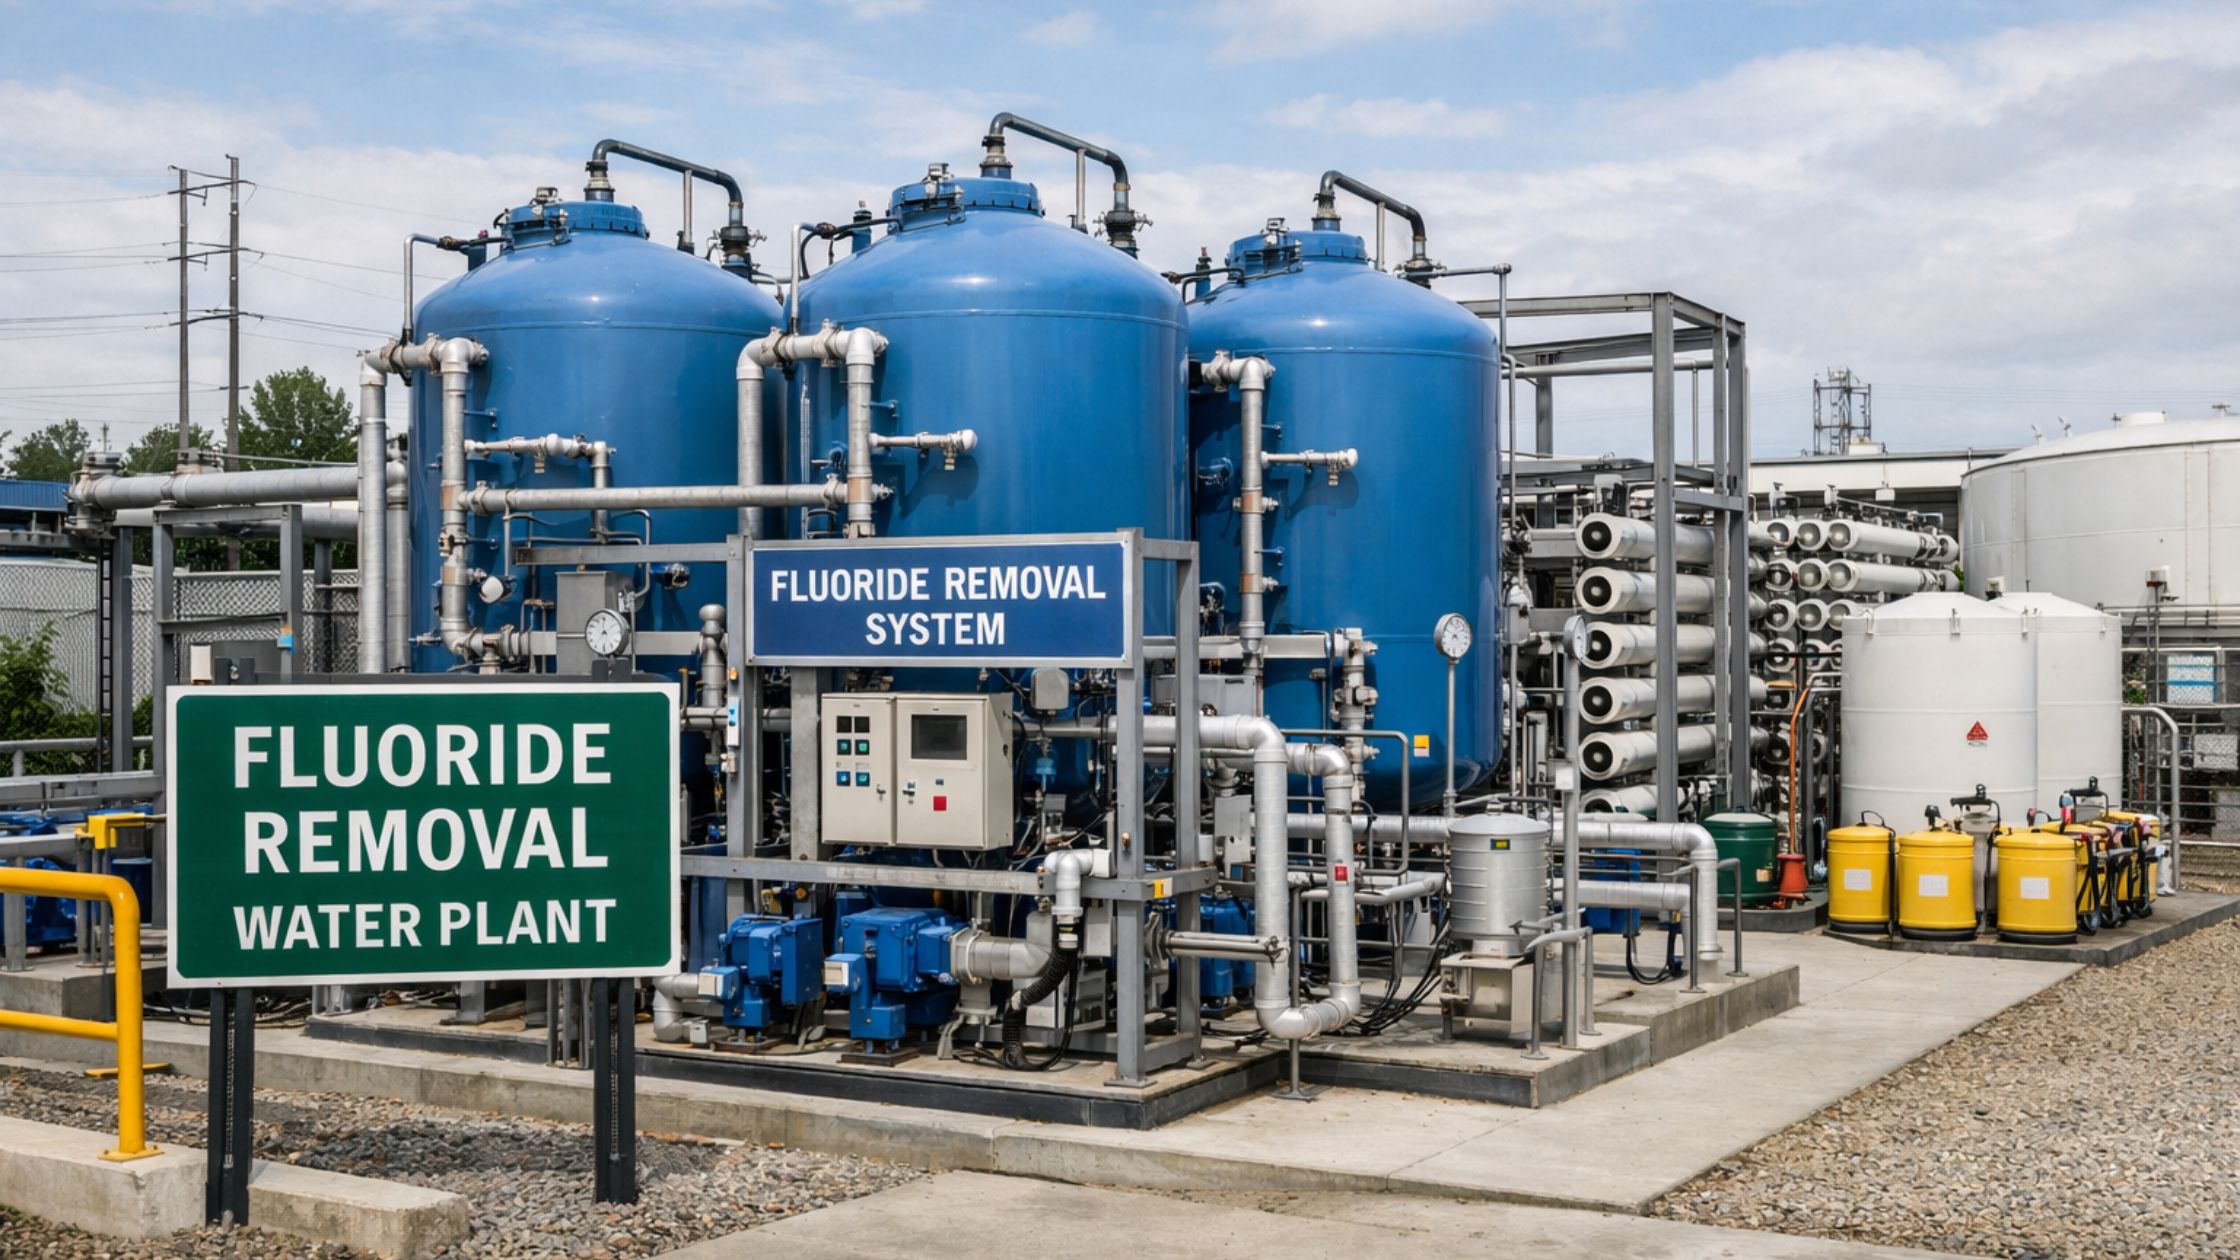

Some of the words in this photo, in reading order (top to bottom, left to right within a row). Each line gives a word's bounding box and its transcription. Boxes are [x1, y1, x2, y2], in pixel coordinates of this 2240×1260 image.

[771, 567, 930, 602] FLUORIDE
[945, 565, 1107, 600] REMOVAL
[865, 612, 1006, 646] SYSTEM
[235, 723, 611, 788] FLUORIDE
[244, 806, 609, 874] REMOVAL
[234, 902, 422, 950] WATER
[440, 899, 617, 946] PLANT
